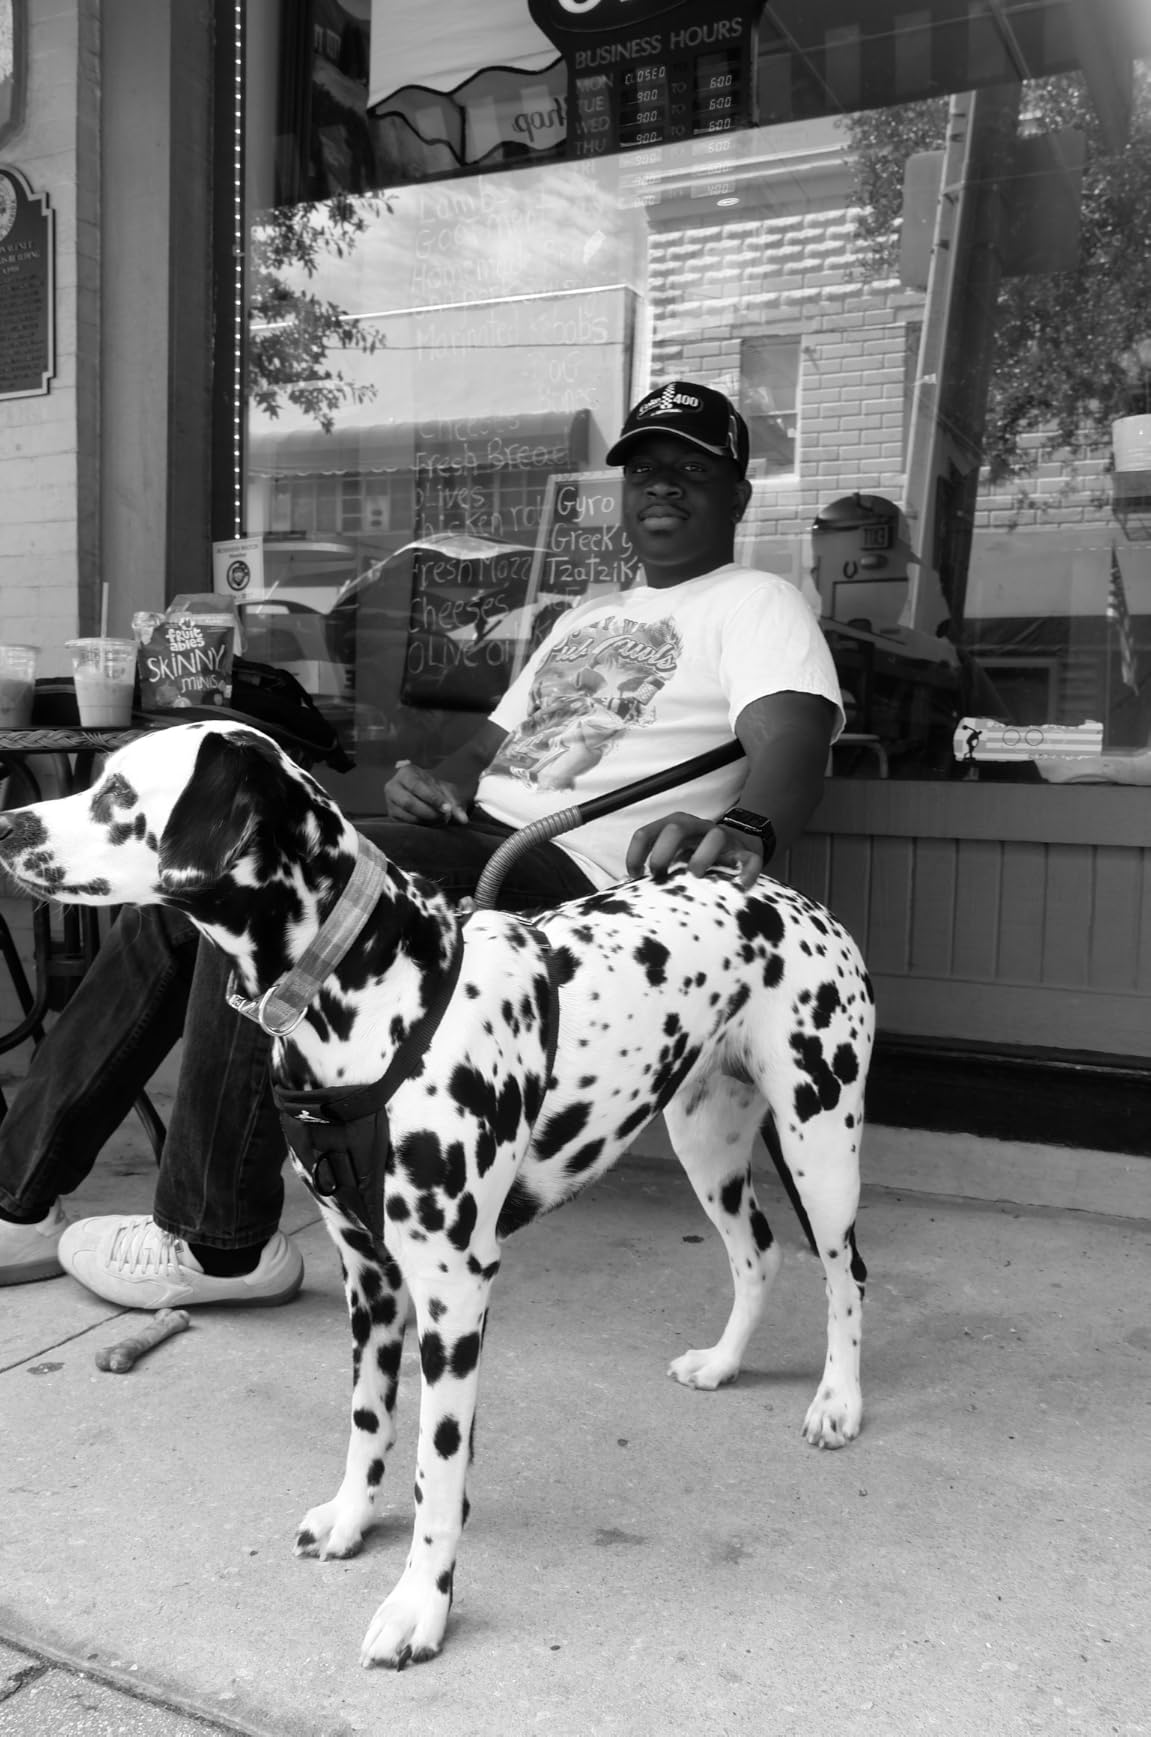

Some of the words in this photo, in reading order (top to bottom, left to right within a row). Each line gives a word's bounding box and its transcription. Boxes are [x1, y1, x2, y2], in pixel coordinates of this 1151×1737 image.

[575, 34, 662, 69] BUSINESS
[670, 17, 742, 49] HOURS
[574, 137, 607, 155] THU
[673, 393, 699, 407] 400
[558, 486, 615, 522] Gyro
